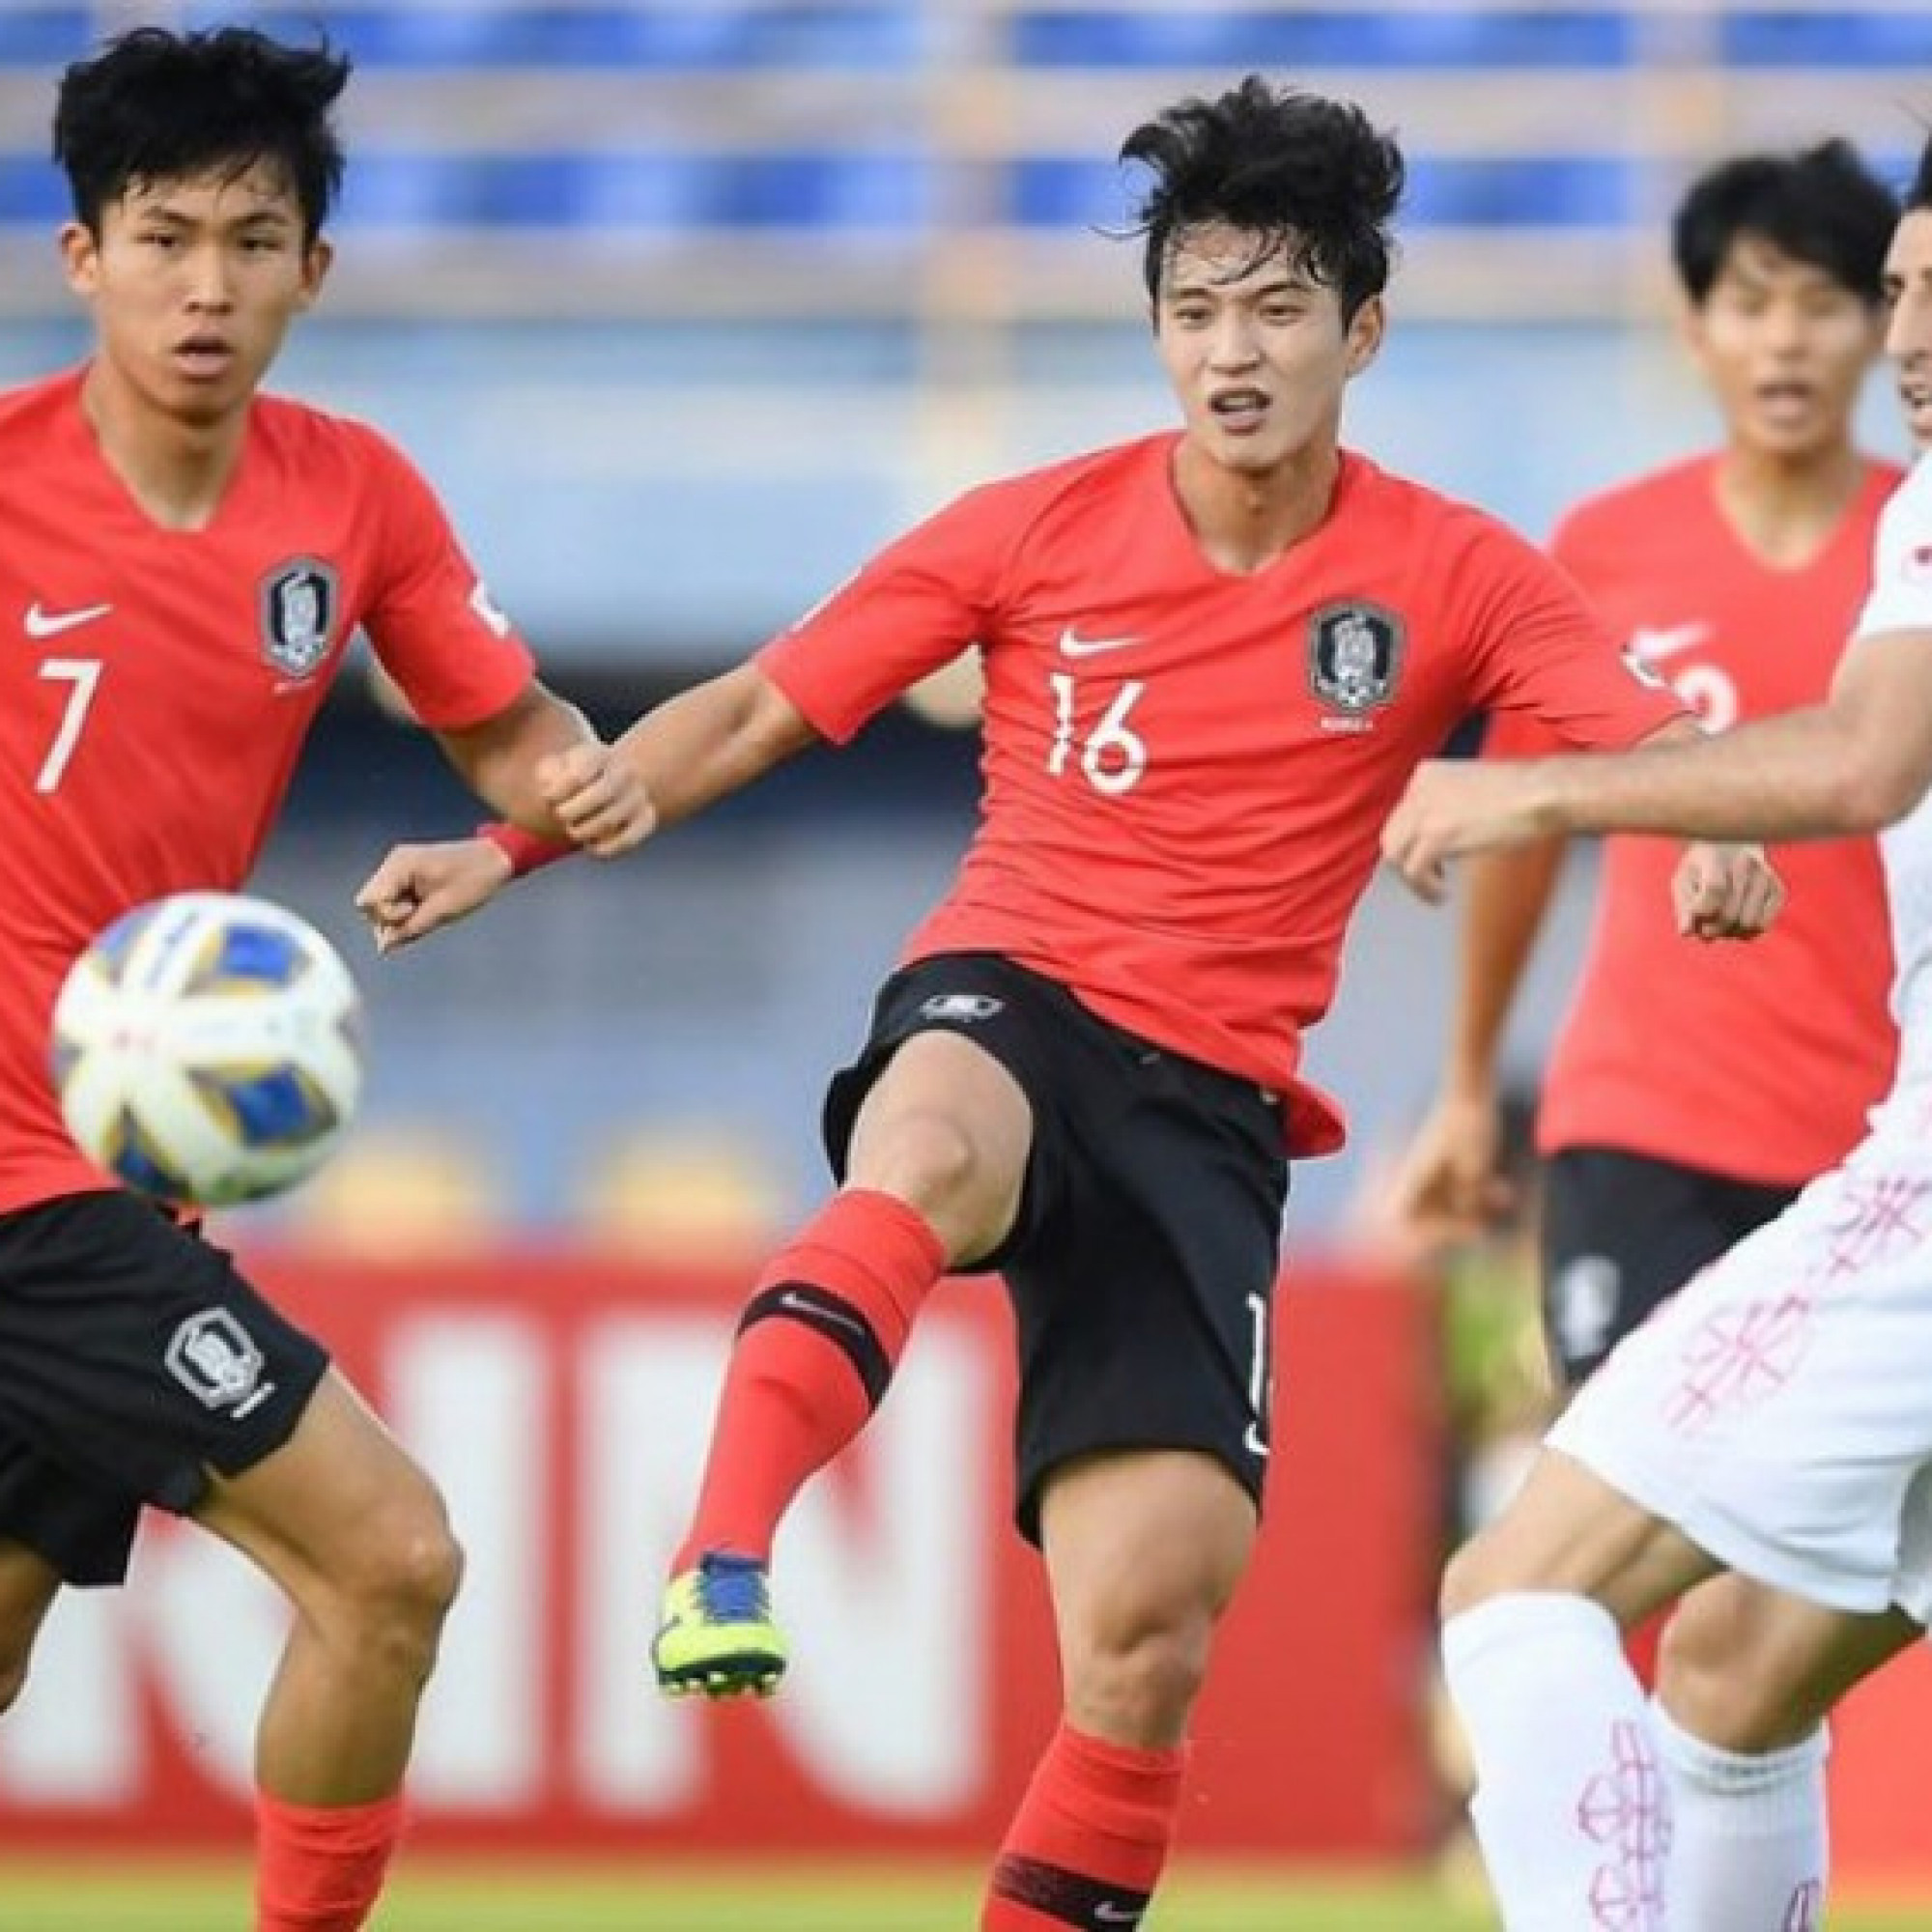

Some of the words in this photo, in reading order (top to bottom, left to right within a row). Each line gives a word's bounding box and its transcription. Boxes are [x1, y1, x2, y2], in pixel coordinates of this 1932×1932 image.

[37, 658, 103, 794] 7
[1047, 671, 1147, 794] 16
[1244, 1291, 1269, 1415] 1
